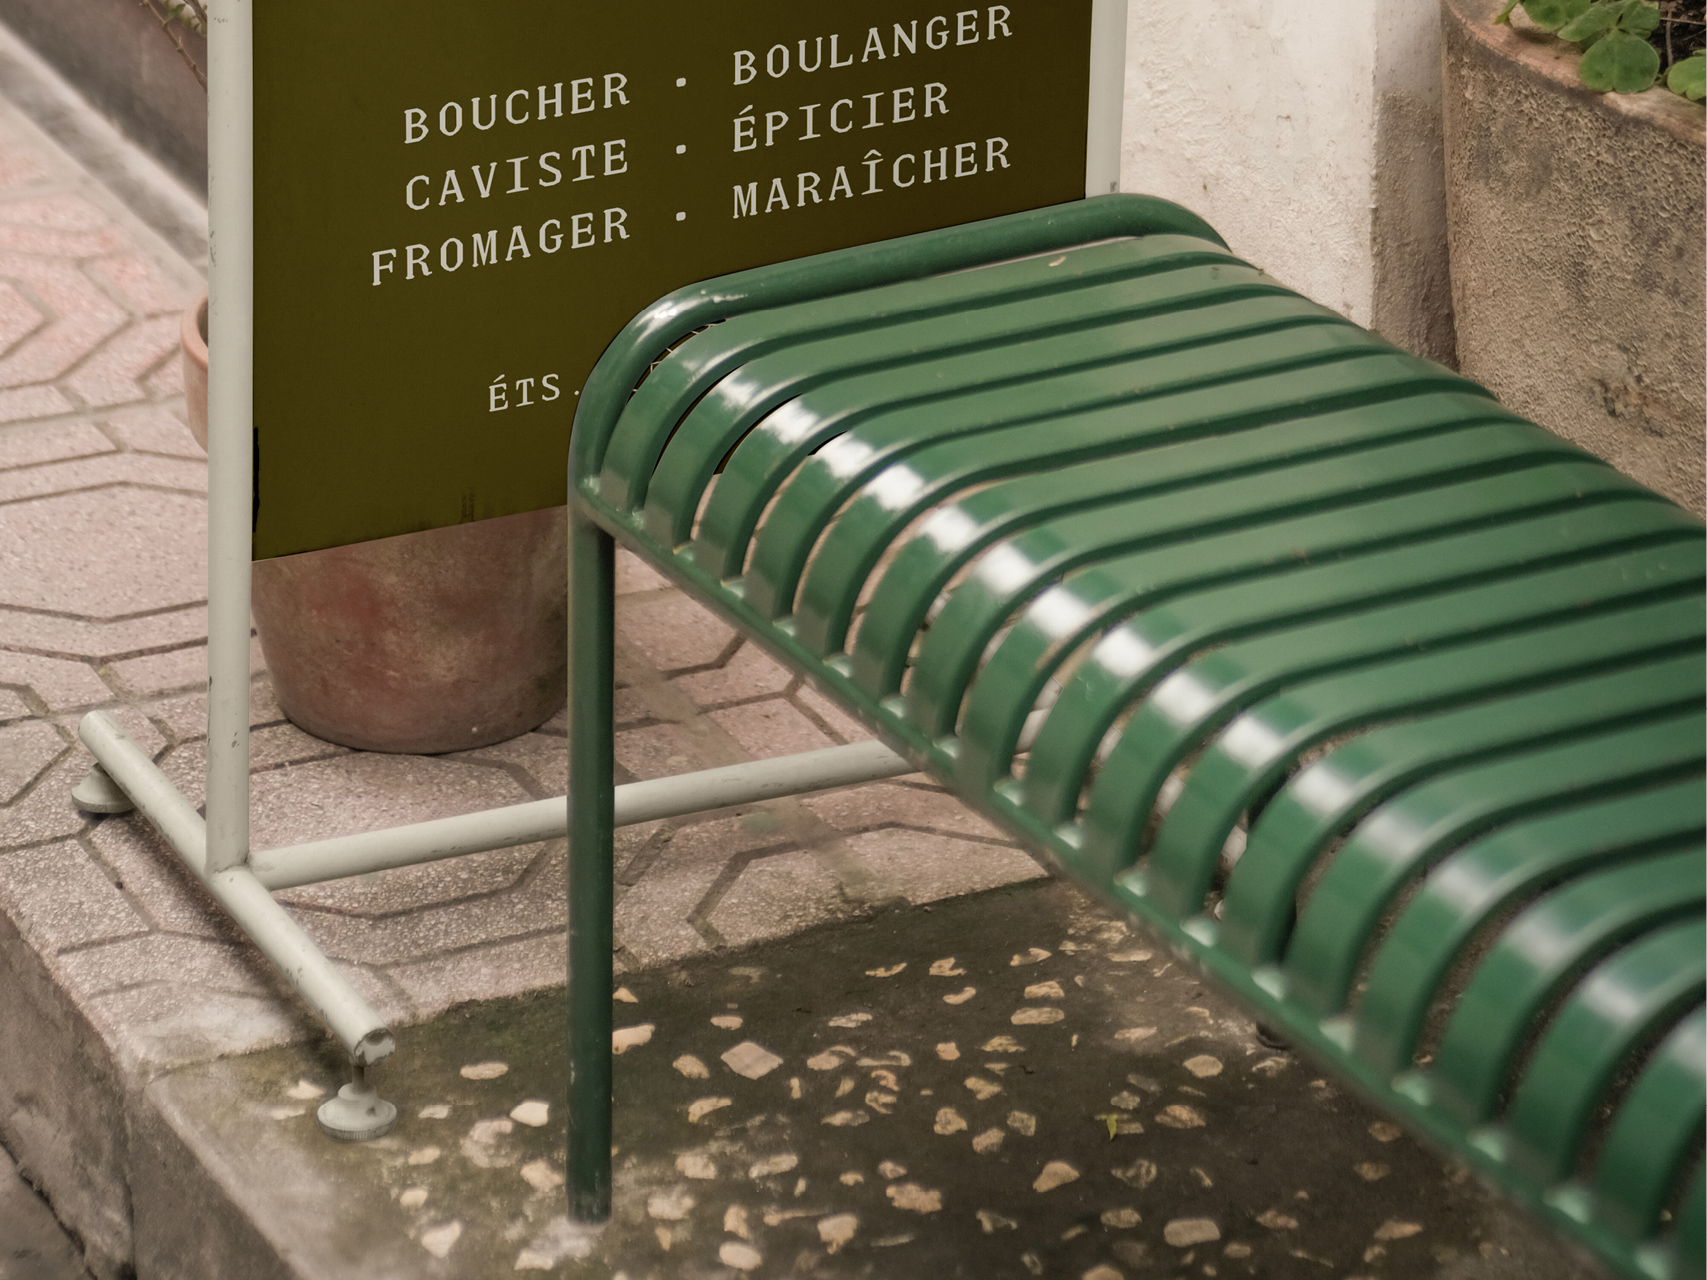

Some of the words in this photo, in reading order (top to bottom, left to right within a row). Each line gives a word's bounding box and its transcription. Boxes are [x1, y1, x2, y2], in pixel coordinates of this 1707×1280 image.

[404, 72, 630, 144] BOUCHER
[733, 4, 1013, 88] BOULANGER
[371, 207, 630, 287] FROMAGER
[732, 136, 1012, 219] MARAÎCHER
[405, 138, 628, 211] CAVISTE
[732, 82, 950, 153] ÉPICIER
[488, 373, 580, 412] ÉTS.
